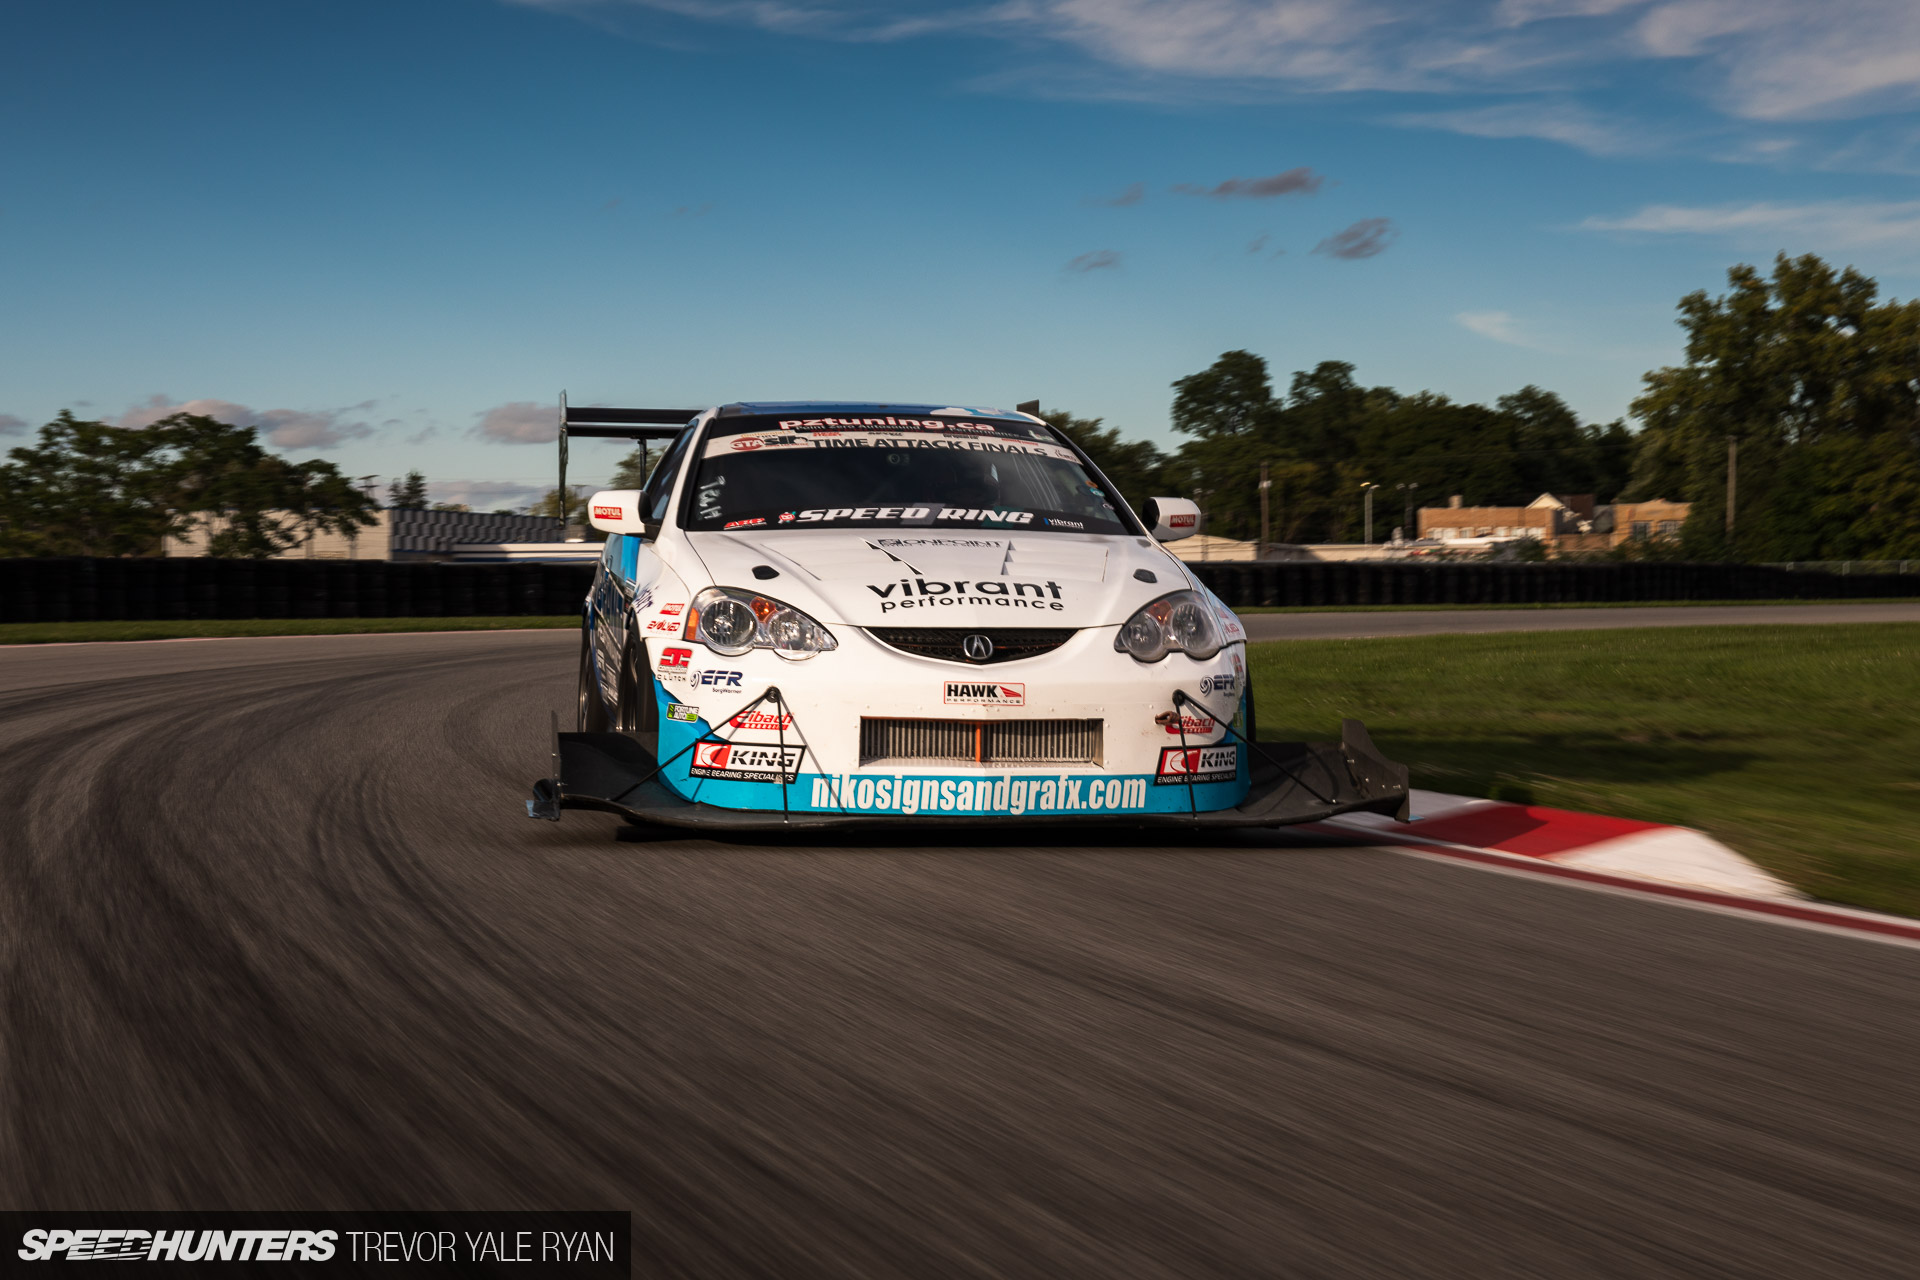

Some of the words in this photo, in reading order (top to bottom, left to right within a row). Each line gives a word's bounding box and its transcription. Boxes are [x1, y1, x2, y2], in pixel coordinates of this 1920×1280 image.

[778, 415, 995, 431] pztuning.ca
[733, 439, 764, 449] GTA
[809, 438, 868, 449] TIME
[873, 438, 962, 451] ATTACK
[966, 440, 1048, 456] FINALS
[594, 507, 621, 516] MOTUL
[796, 507, 931, 523] SPEED
[936, 507, 1035, 524] RING
[1171, 514, 1194, 524] MOTUL
[1048, 518, 1085, 529] vibrant
[866, 578, 1063, 599] vibrant
[880, 596, 1065, 613] performance
[656, 673, 687, 682] CLUTCH
[701, 670, 744, 687] EFR
[947, 684, 998, 698] HAWK
[730, 749, 796, 767] KING
[1201, 750, 1235, 768] KING
[711, 768, 742, 778] BEARING
[1157, 774, 1184, 784] ENGINE
[811, 773, 1146, 815] nikosignsandgrafx.com
